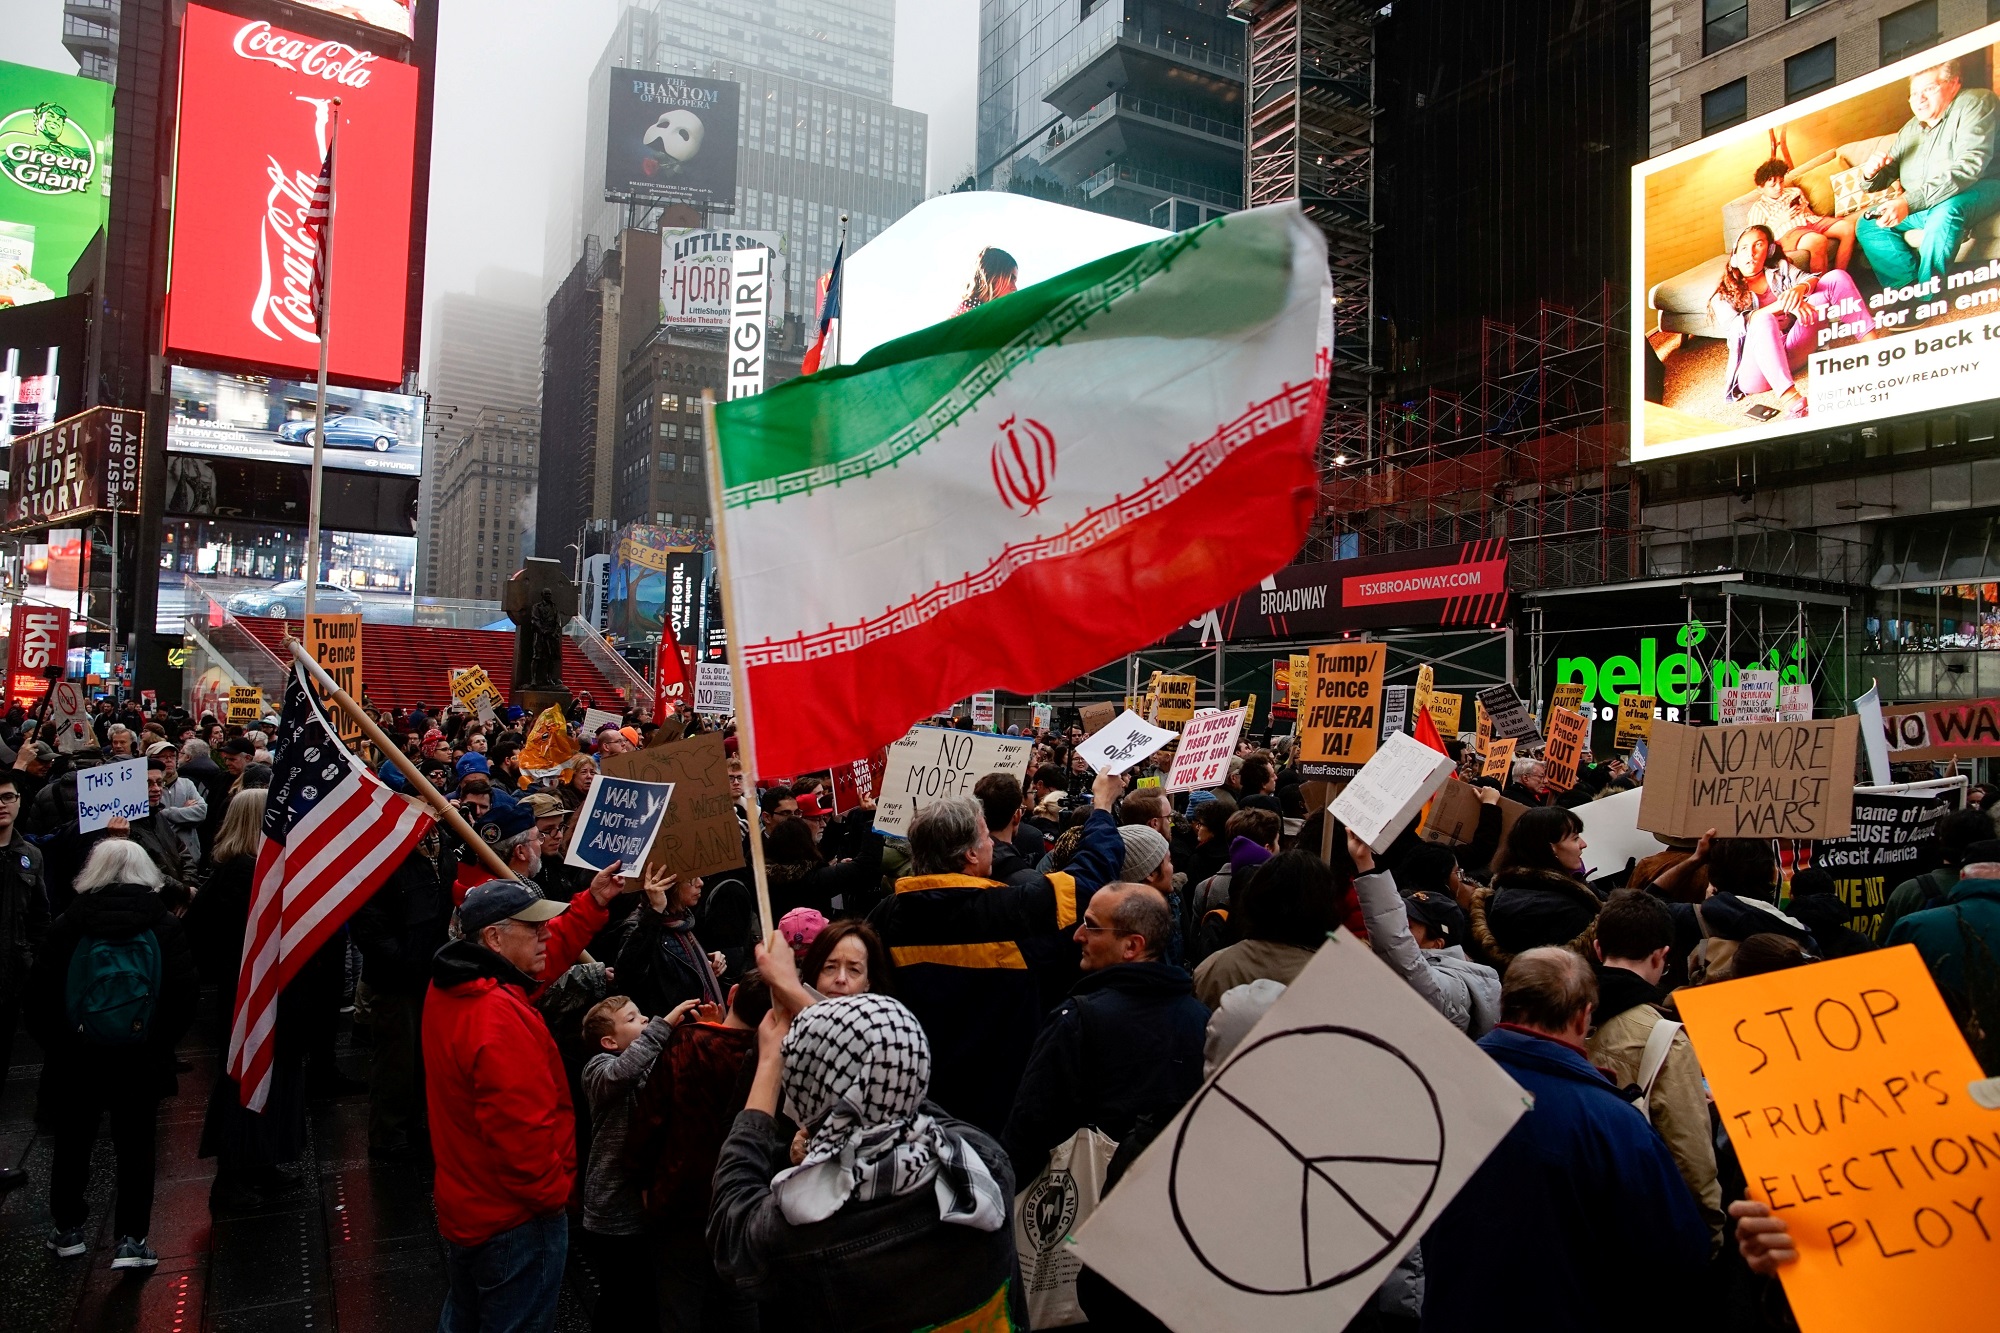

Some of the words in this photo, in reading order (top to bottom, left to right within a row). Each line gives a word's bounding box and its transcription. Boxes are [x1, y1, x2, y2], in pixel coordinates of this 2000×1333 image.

[233, 20, 378, 88] Coca-Cola
[632, 80, 719, 103] PHANTOM
[665, 77, 687, 87] THE
[640, 93, 654, 103] OF
[655, 95, 676, 105] THE
[677, 98, 710, 109] OPERA
[6, 143, 89, 172] Green
[15, 164, 91, 192] Giant
[674, 233, 732, 261] LITTLE
[672, 264, 731, 315] HORR
[1816, 297, 1861, 322] Talk
[1869, 277, 1941, 308] about
[666, 315, 697, 324] Westside
[698, 316, 723, 325] Theatre
[733, 257, 764, 398] ERGIRL
[1818, 320, 1867, 346] plan
[1874, 309, 1909, 330] for
[1916, 300, 1948, 320] an
[1816, 355, 1869, 376] Then
[1878, 347, 1906, 367] go
[1915, 329, 1973, 356] back
[1817, 389, 1844, 401] VISIT
[1847, 361, 1980, 396] NYC.GOV/READYNY
[1870, 392, 1889, 403] 311
[109, 412, 123, 453] SIDE
[175, 414, 197, 427] The
[199, 418, 235, 430] sedan
[27, 422, 82, 464] WEST
[175, 425, 185, 435] is
[187, 427, 212, 437] new
[214, 430, 249, 442] again.
[27, 452, 77, 492] SIDE
[123, 431, 137, 492] STORY
[379, 460, 415, 470] HYUNDAI
[107, 459, 121, 507] WEST
[20, 480, 84, 520] STORY
[684, 577, 692, 604] square
[1260, 584, 1328, 616] BROADWAY
[1359, 571, 1481, 596] TSXBROADWAY.COM
[683, 606, 691, 629] times
[23, 613, 60, 668] tkts
[314, 618, 359, 643] Trump/
[317, 642, 356, 664] Pence
[1316, 650, 1378, 677] Trump/
[452, 681, 463, 690] U.S.
[462, 668, 480, 682] TROOPS
[458, 682, 475, 698] OUT
[475, 674, 486, 687] OF
[1168, 682, 1191, 698] WAR/
[1317, 677, 1369, 698] Pence
[230, 697, 260, 705] BOMBING
[236, 688, 258, 698] STOP
[698, 689, 712, 704] NO
[1158, 698, 1192, 709] SANCTIONS
[1554, 697, 1569, 707] OUT
[1570, 697, 1582, 706] OF
[1624, 698, 1639, 708] U.S.
[1640, 701, 1652, 709] OUT
[1740, 691, 1772, 699] REPUBLICAN
[232, 706, 257, 718] IRAQ!
[1307, 705, 1374, 729] ¡FUERA
[1435, 706, 1454, 716] IRAQ,
[1508, 709, 1518, 717] the
[1556, 708, 1585, 731] Trump/
[1625, 709, 1633, 717] of
[1634, 709, 1649, 720] Iraq,
[1186, 723, 1201, 736] ALL
[1202, 714, 1239, 732] PURPOSE
[1500, 720, 1511, 728] U.S.
[1511, 717, 1523, 725] War
[1504, 724, 1530, 736] Machine!
[1554, 723, 1578, 744] Pence
[998, 744, 1022, 754] ENUFF
[1121, 741, 1138, 753] IS
[1127, 730, 1152, 746] WAR
[1185, 737, 1211, 751] PISSED
[1212, 731, 1229, 745] OFF
[1321, 733, 1353, 756] YA!
[937, 734, 974, 770] NO
[1175, 751, 1208, 767] PROTEST
[1209, 746, 1230, 760] SIGN
[1489, 742, 1513, 758] Trump/
[1549, 738, 1575, 764] OUT
[1697, 724, 1748, 775] NO
[1752, 726, 1836, 771] MORE
[854, 764, 870, 776] WAR
[994, 760, 1022, 768] ENUFF!
[1174, 768, 1198, 786] FUCK
[1202, 763, 1219, 781] 45
[1487, 759, 1506, 771] Pence
[854, 773, 872, 787] WITH
[605, 786, 639, 809] WAR
[1693, 776, 1829, 807] IMPERIALIST
[592, 809, 601, 818] IS
[601, 811, 625, 829] NOT
[625, 817, 639, 828] THE
[1735, 801, 1820, 836] WARS
[1856, 806, 1898, 822] name
[1902, 806, 1918, 823] of
[589, 831, 645, 856] ANSWER!
[1894, 827, 1908, 843] to
[1819, 853, 1828, 868] a
[1873, 846, 1918, 864] America
[1733, 988, 1900, 1075] STOP
[1733, 1070, 1950, 1139] TRUMP'S
[1759, 1131, 2000, 1212] ELECTION
[1061, 1196, 1075, 1226] NYC
[1826, 1196, 1992, 1267] PLOY
